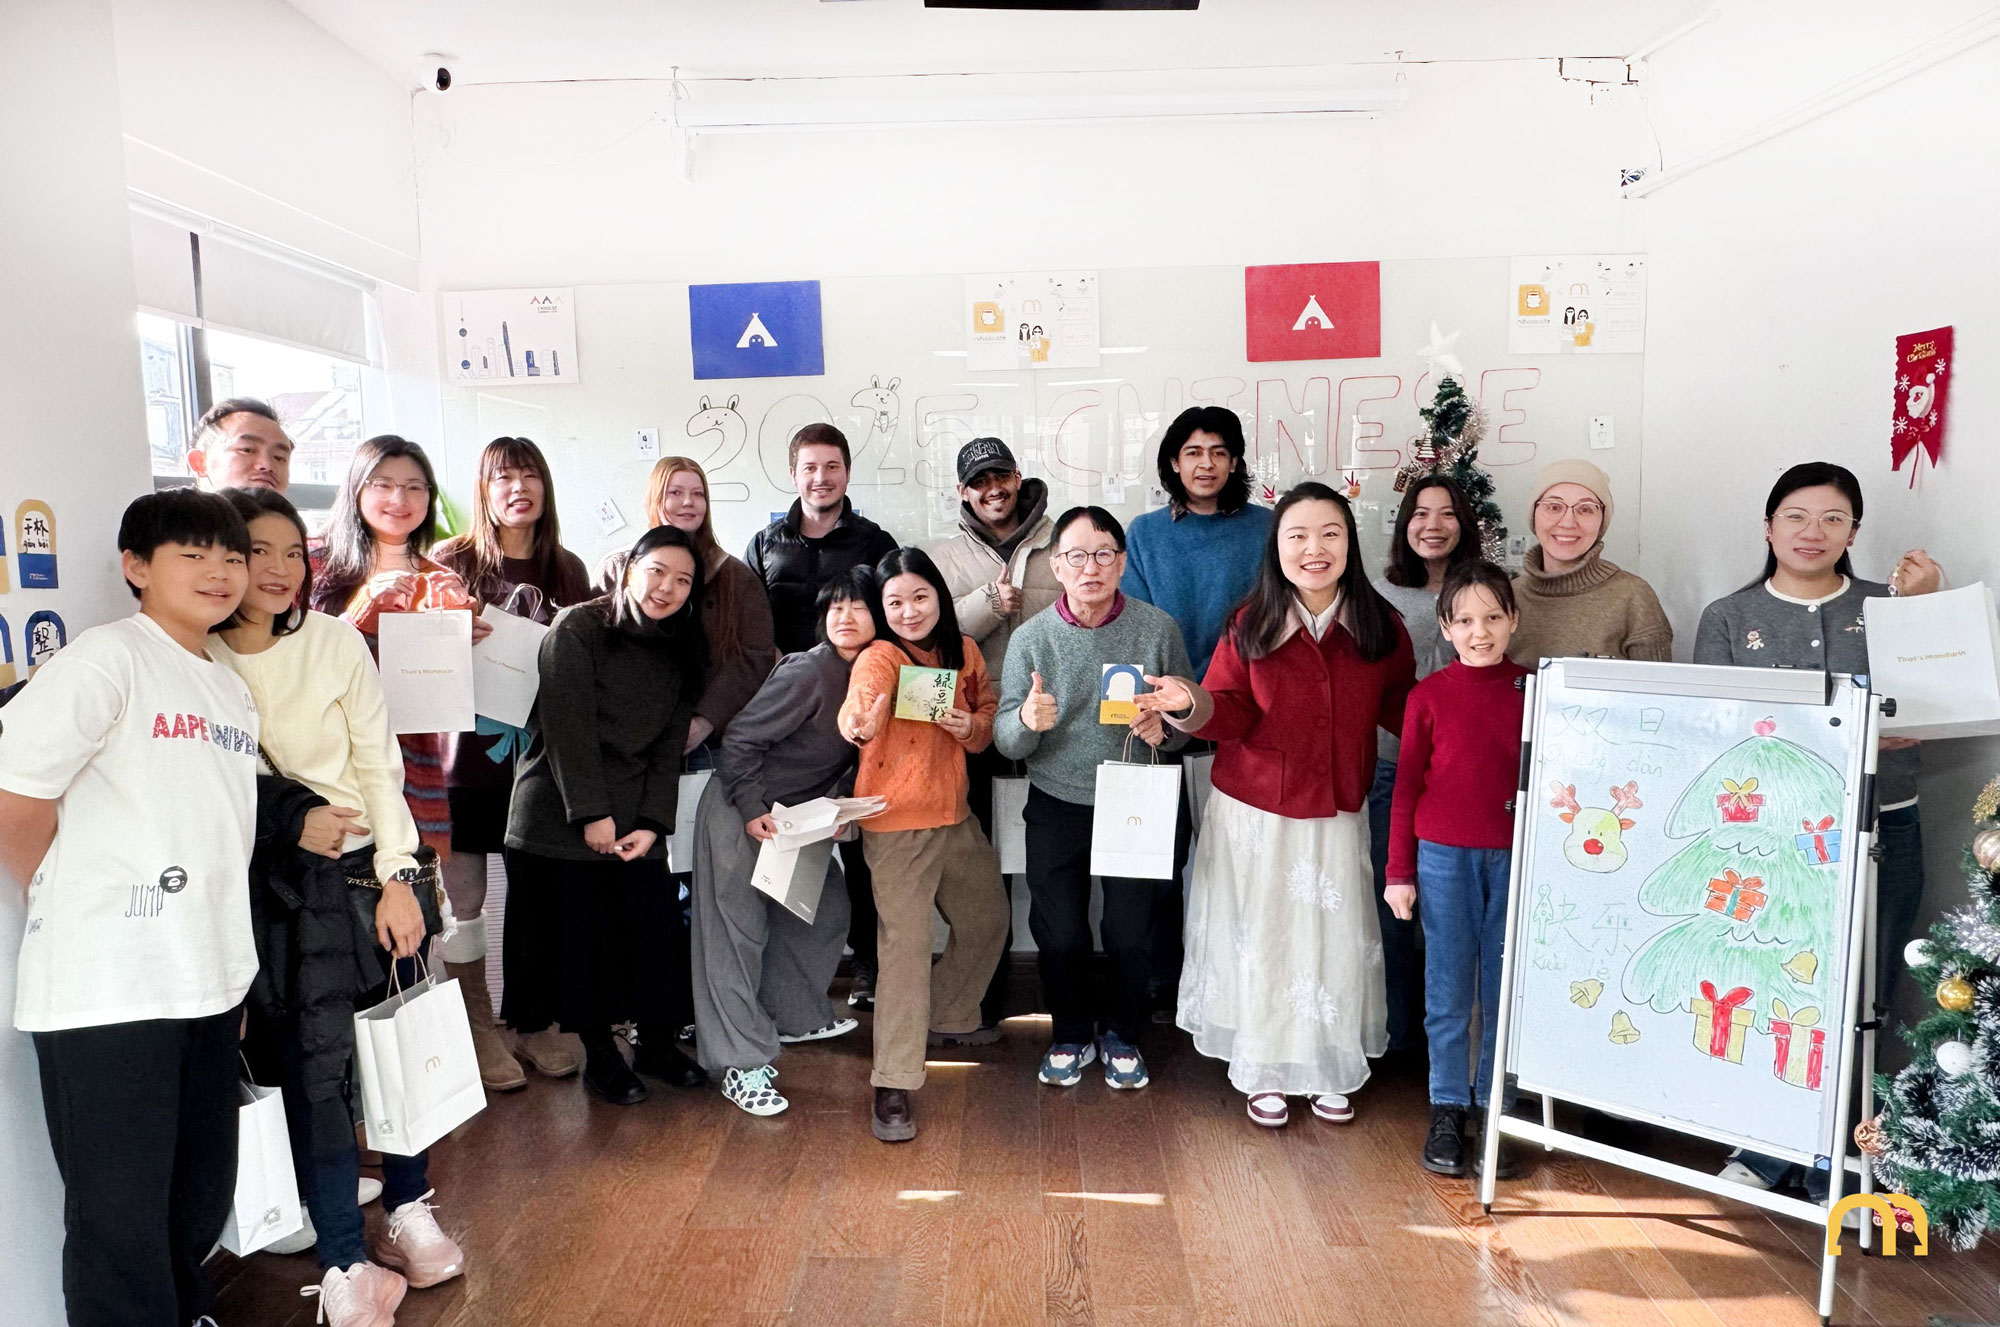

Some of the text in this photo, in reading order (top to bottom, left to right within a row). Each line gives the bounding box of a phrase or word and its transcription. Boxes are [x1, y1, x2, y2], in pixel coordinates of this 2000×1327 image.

[686, 367, 1541, 502] 2025 CHNEE
[23, 517, 49, 537] 干杯
[152, 712, 209, 742] AAPE
[125, 884, 165, 918] JUMP
